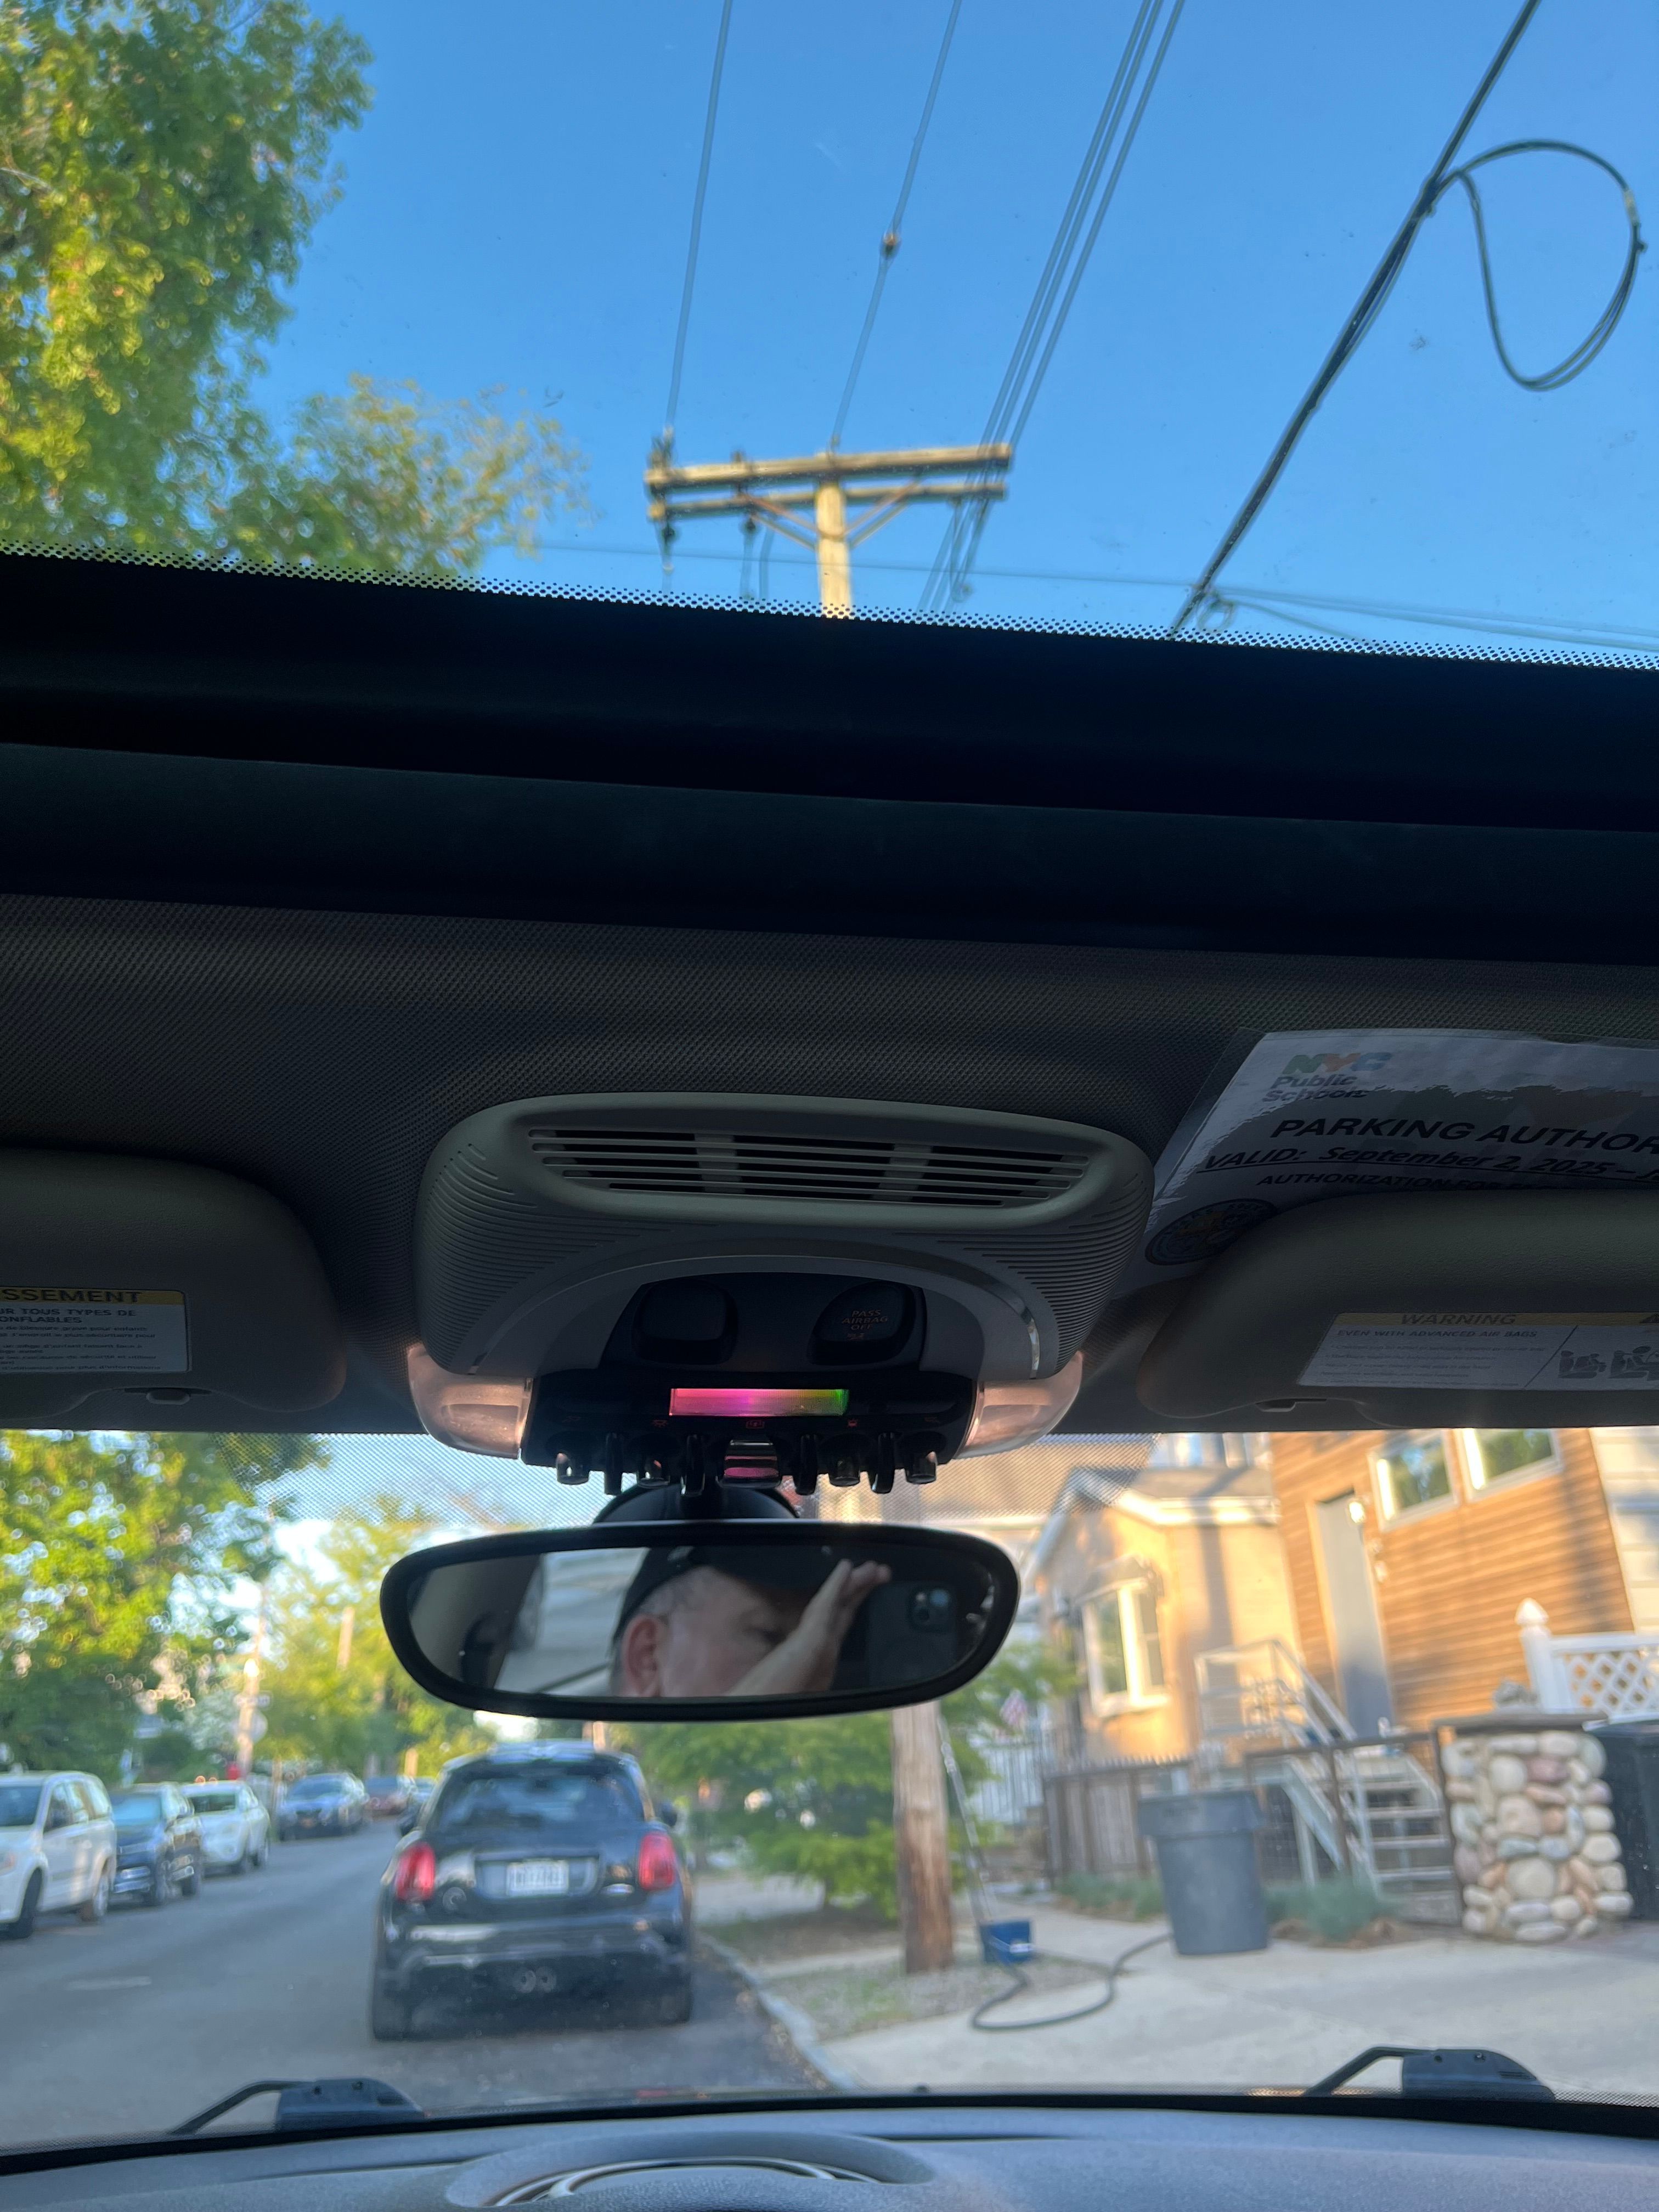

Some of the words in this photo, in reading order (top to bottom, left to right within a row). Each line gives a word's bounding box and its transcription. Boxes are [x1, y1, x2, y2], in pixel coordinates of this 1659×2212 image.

[1282, 1052, 1392, 1075] NYC
[1271, 1074, 1357, 1088] Public
[1262, 1087, 1369, 1102] Schools
[1270, 1118, 1475, 1140] PARKING
[1204, 1148, 1307, 1169] VALID:
[1319, 1147, 1494, 1166] September
[1492, 1155, 1522, 1171] 2,
[1529, 1158, 1616, 1175] 2025
[1256, 1173, 1451, 1190] AUTHORIZATION
[2, 1289, 142, 1302] SSEMENT
[1401, 1314, 1517, 1325] WARNING
